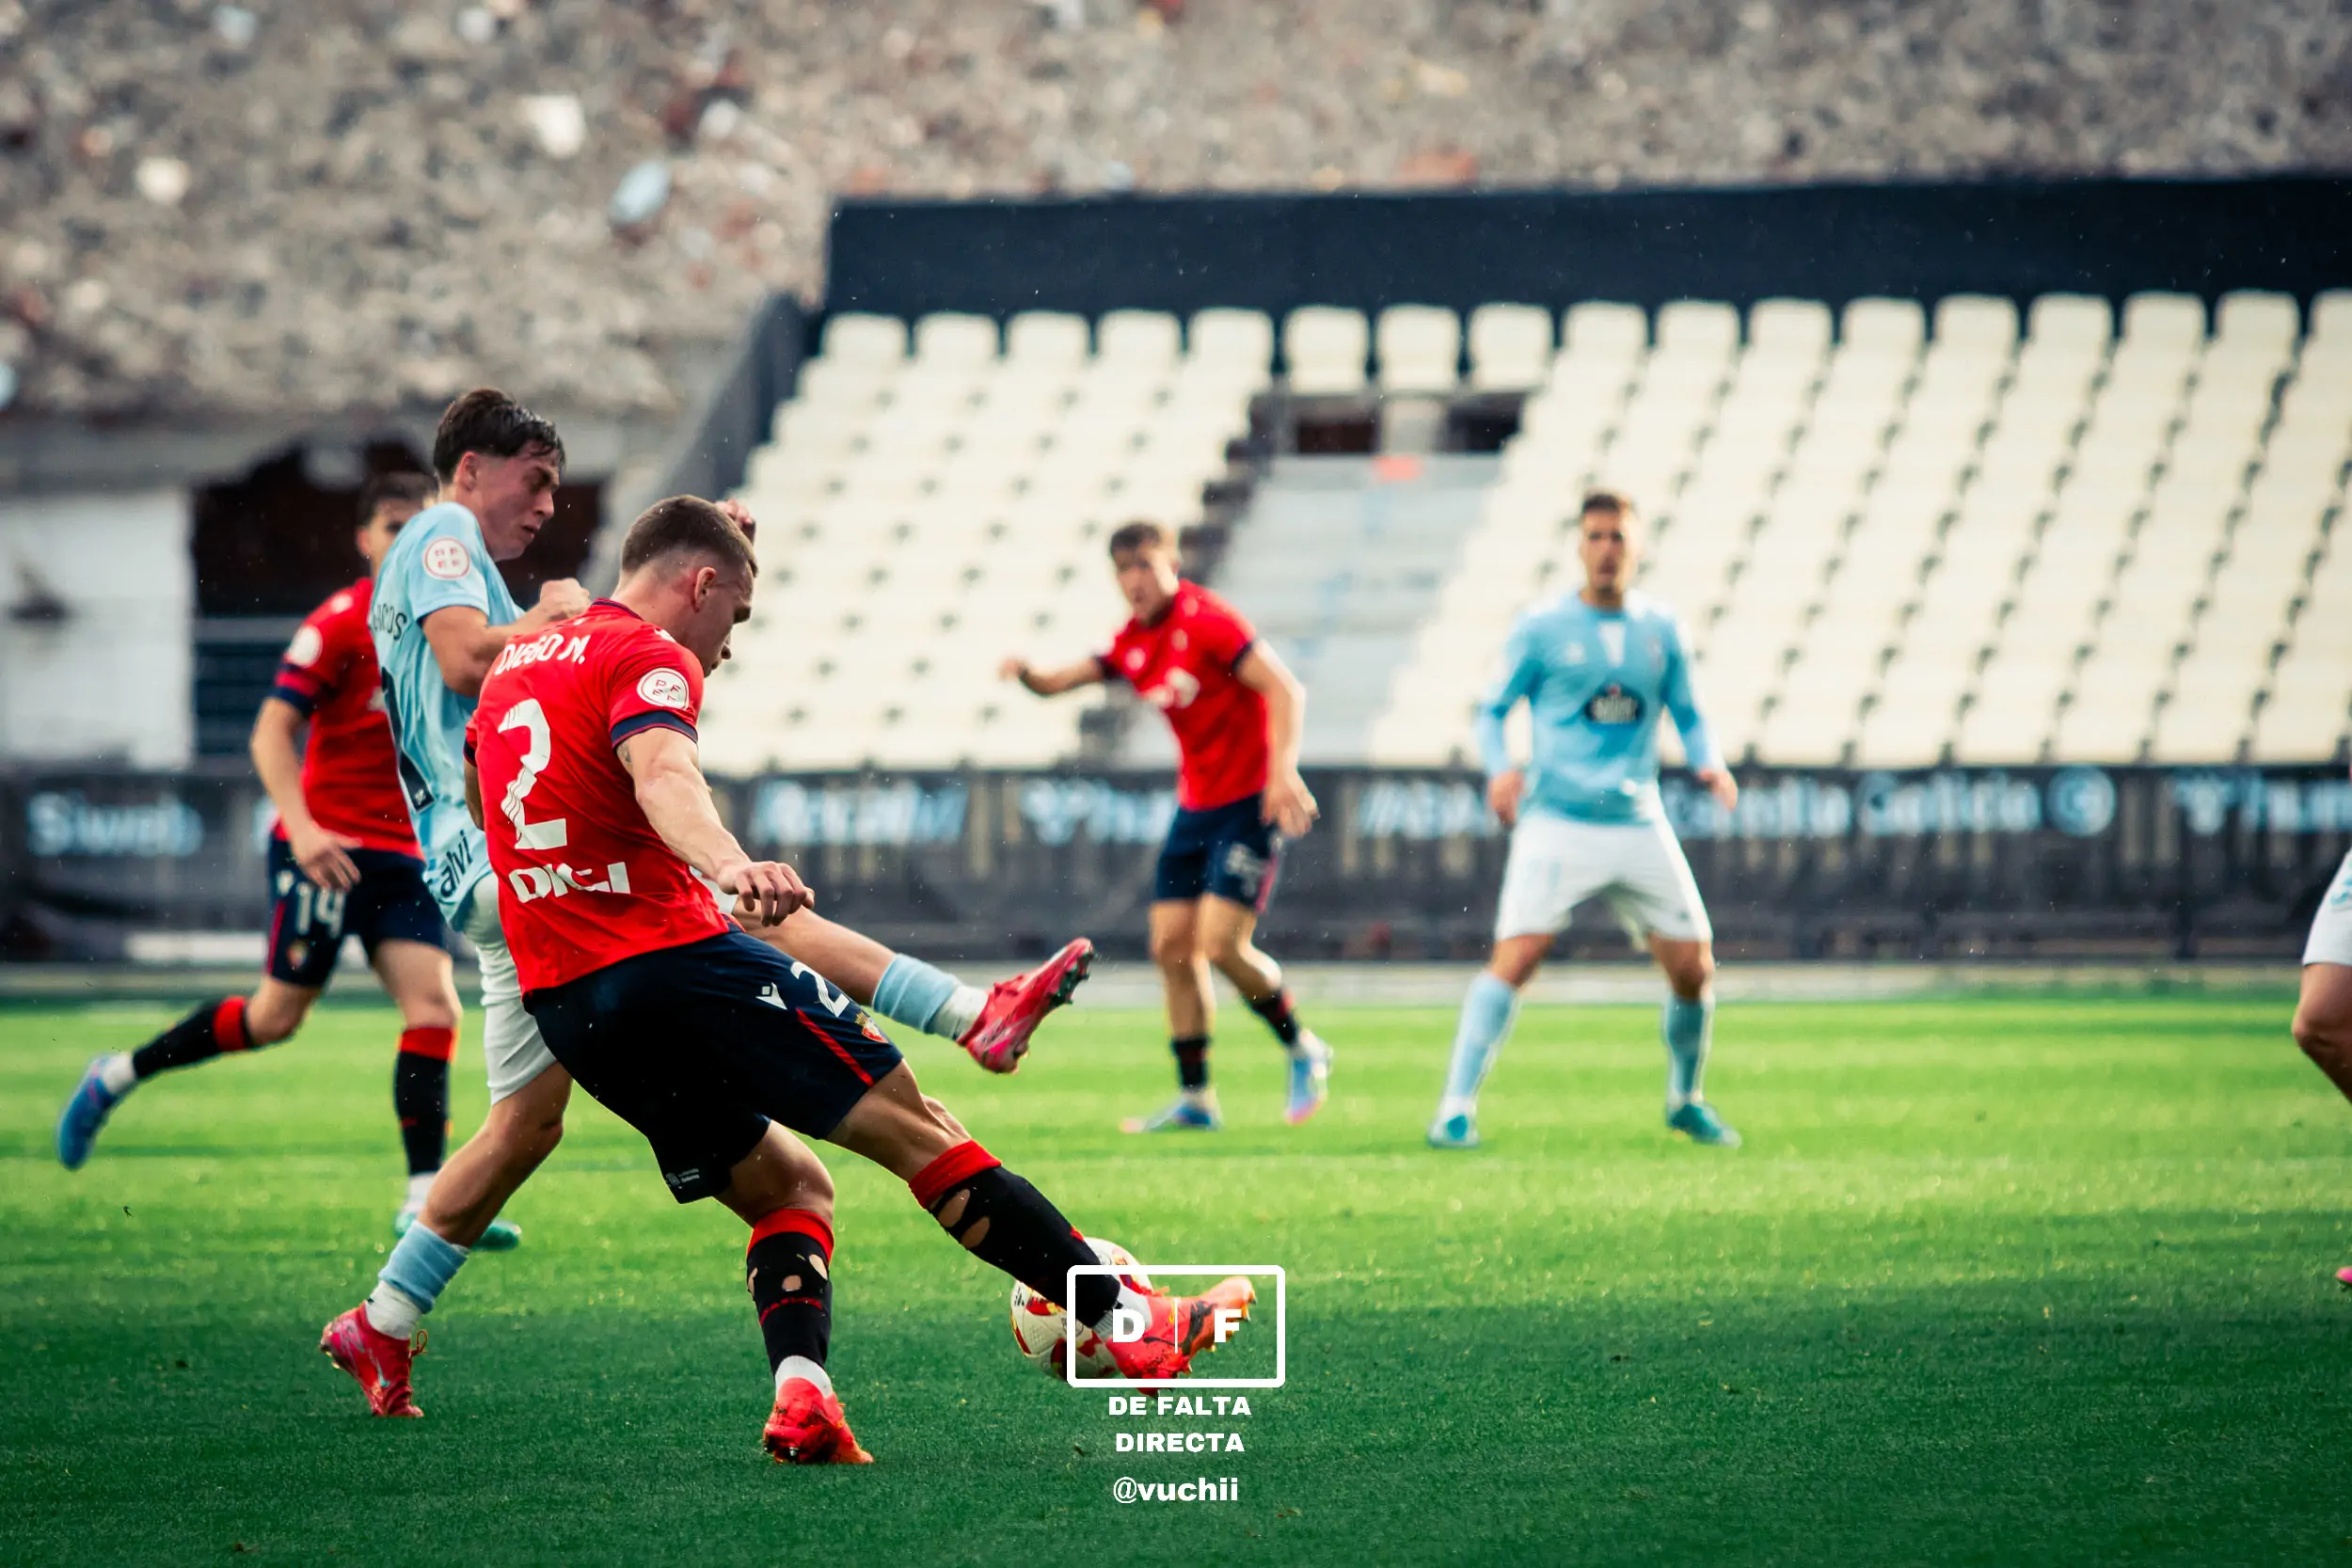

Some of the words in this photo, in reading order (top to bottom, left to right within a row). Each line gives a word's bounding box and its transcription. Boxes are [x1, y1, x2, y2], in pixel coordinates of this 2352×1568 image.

[494, 633, 564, 674] DIEGO
[498, 698, 568, 850] 2
[438, 829, 473, 898] alvi
[296, 880, 346, 939] 14
[790, 960, 850, 1018] 2
